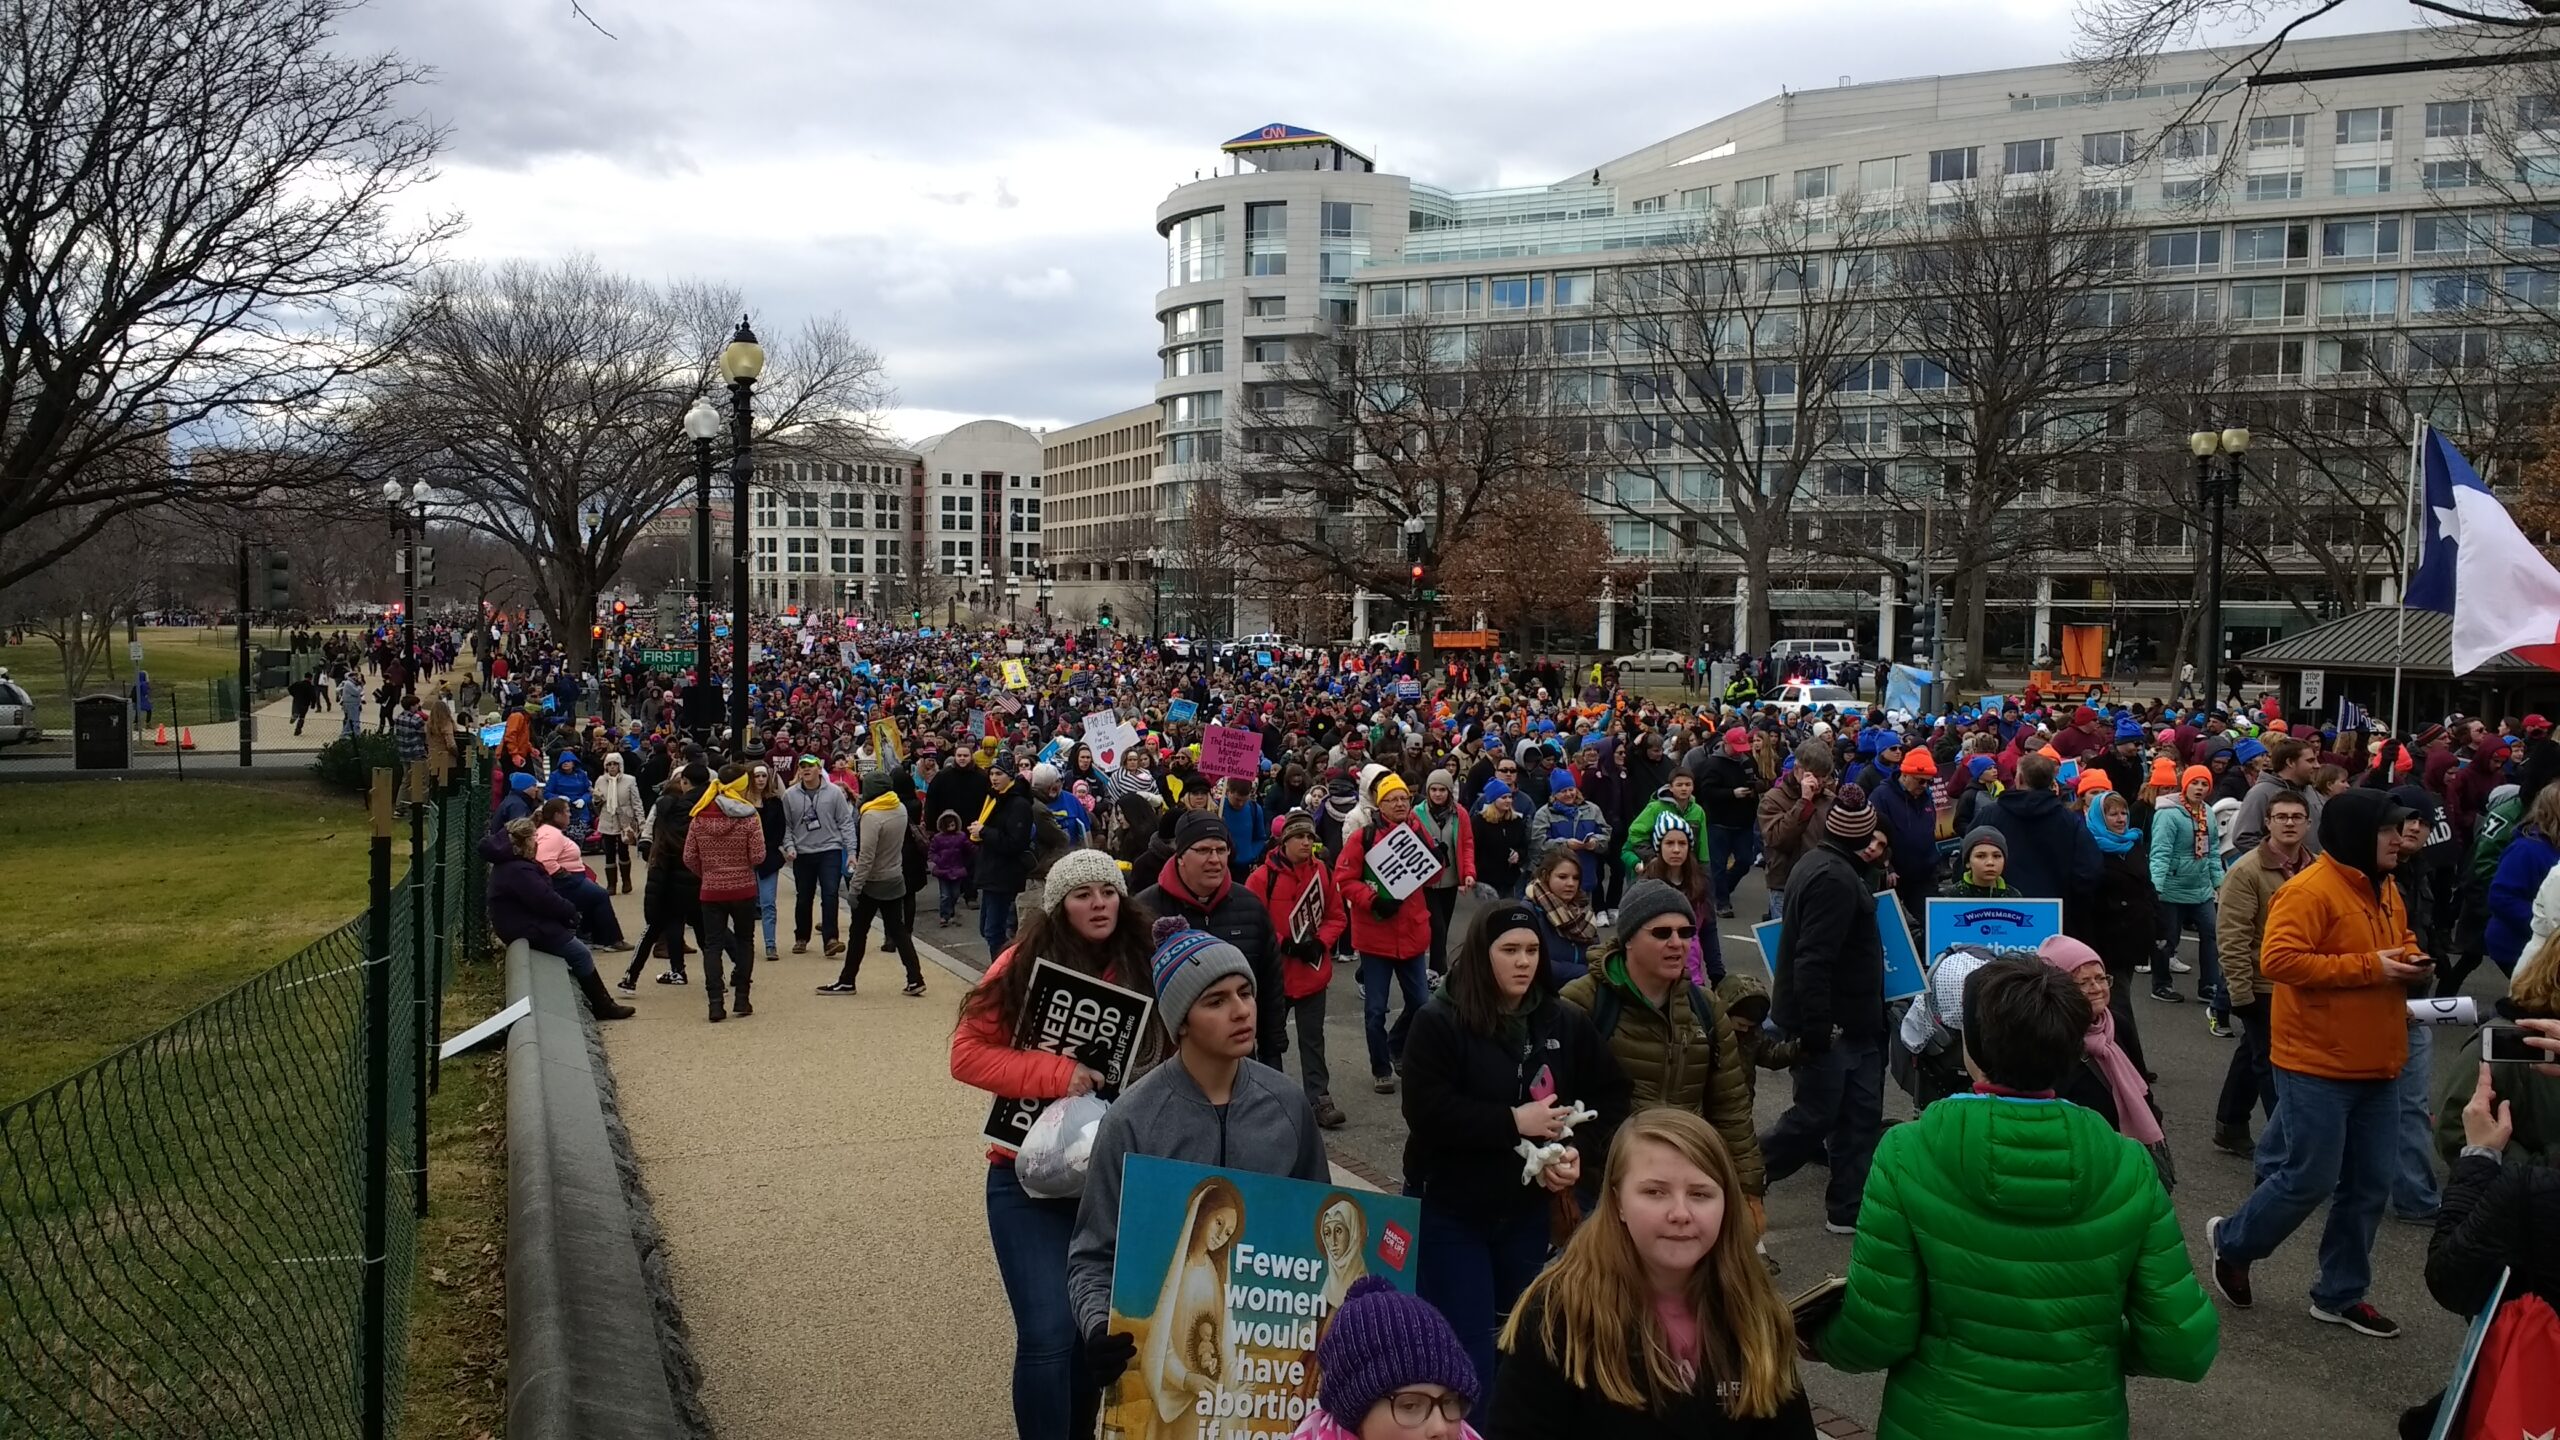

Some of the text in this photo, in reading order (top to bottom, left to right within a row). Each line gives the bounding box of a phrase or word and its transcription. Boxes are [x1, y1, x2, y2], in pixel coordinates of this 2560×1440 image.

[1261, 125, 1287, 139] CNN
[643, 650, 682, 663] FIRST
[656, 664, 680, 672] UNIT
[2305, 672, 2321, 681] STOP
[2305, 686, 2318, 695] RED
[1210, 737, 1255, 752] The Legalized
[1221, 730, 1246, 741] Abolish
[1218, 747, 1243, 758] Murder
[1201, 761, 1255, 778] Unborn Children
[1387, 829, 1436, 881] CHOOSE
[1376, 853, 1409, 887] LIFE
[1036, 988, 1073, 1056] NEED
[1382, 1234, 1395, 1248] FOR
[1393, 1242, 1406, 1255] LIFE
[1385, 1227, 1406, 1247] MARCH
[1235, 1243, 1322, 1283] Fewer
[1224, 1284, 1328, 1318] women
[1232, 1319, 1318, 1352] would
[1236, 1349, 1305, 1386] have
